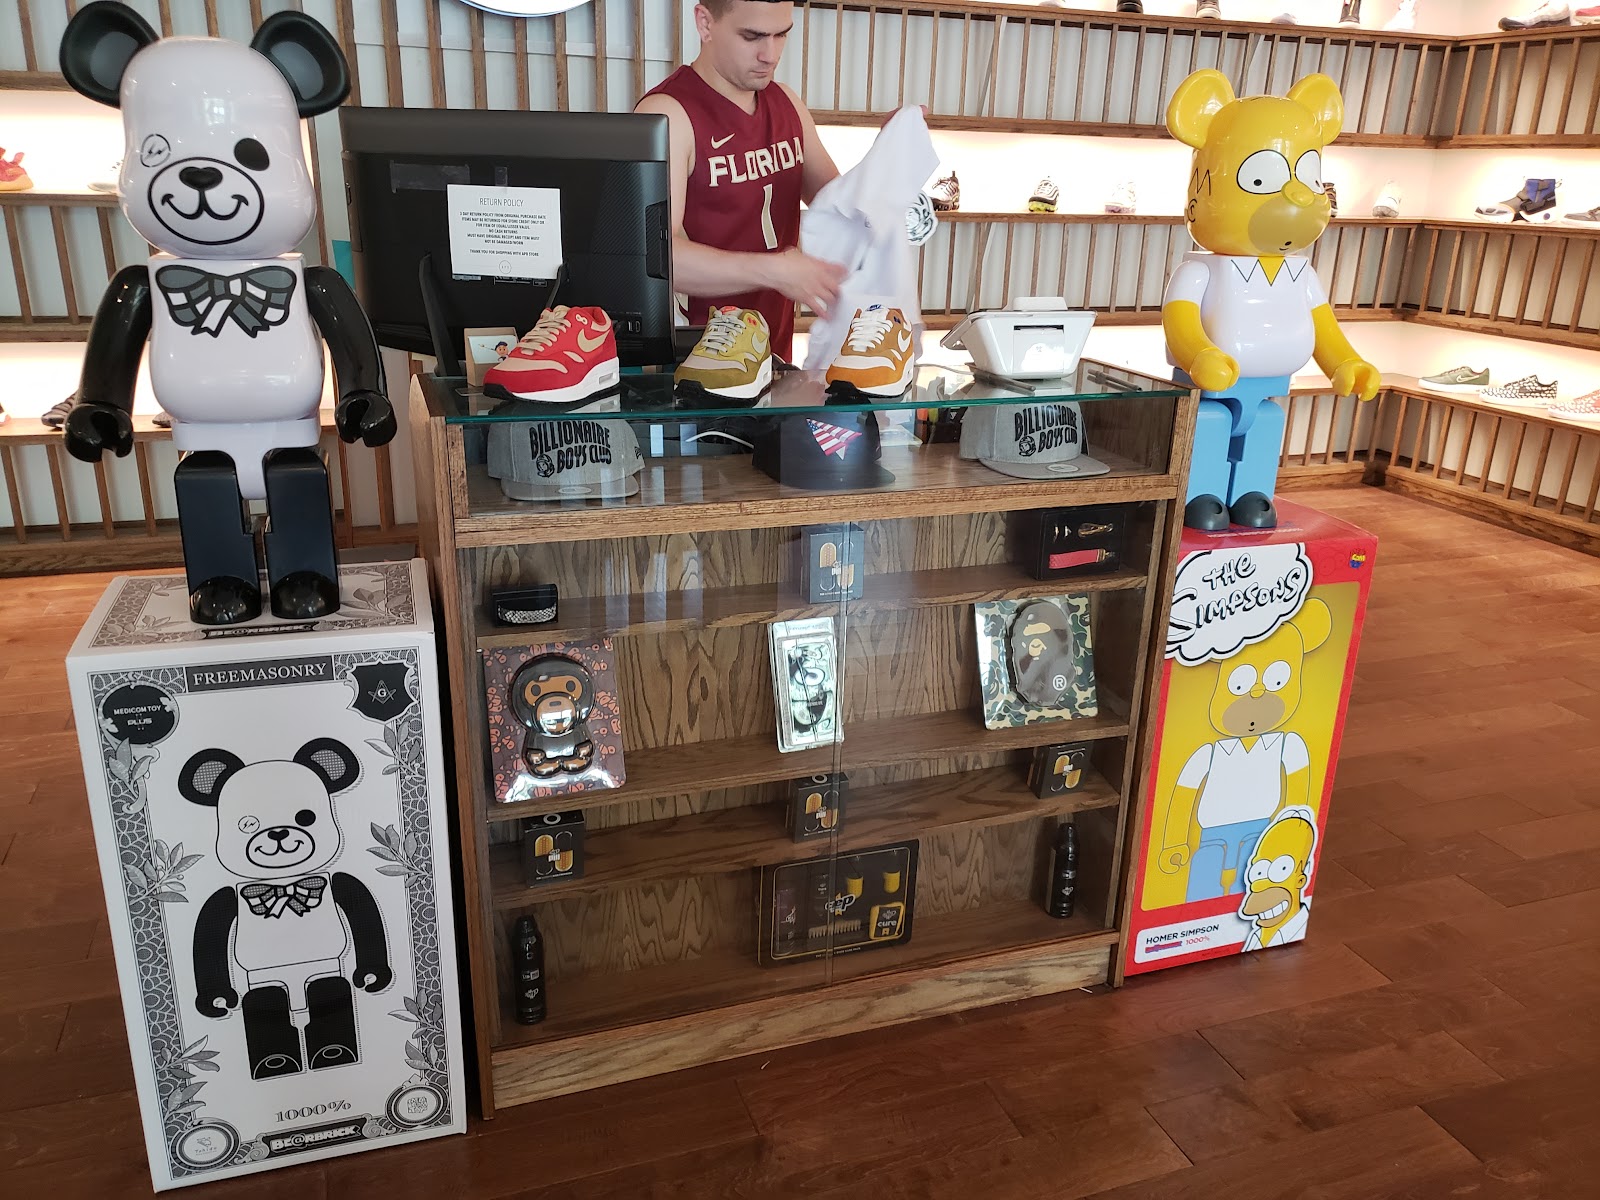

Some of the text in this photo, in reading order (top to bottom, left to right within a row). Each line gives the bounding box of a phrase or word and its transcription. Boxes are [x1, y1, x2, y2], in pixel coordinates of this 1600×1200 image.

[708, 136, 804, 187] FLORIDA
[479, 197, 524, 207] RETURN POLICY
[762, 183, 778, 250] 1
[1014, 404, 1078, 442] BILLIONAIRE
[529, 420, 611, 460] BILLIONAIRE
[1038, 426, 1078, 453] BOYS CLUB
[557, 444, 612, 474] BOYS CLUB
[192, 662, 327, 687] FREEMASONRY
[377, 688, 387, 698] G
[113, 704, 162, 715] MEDICOM TOY
[127, 717, 153, 726] PLUS
[1145, 924, 1220, 945] HOMER SIMPSON
[1185, 935, 1210, 946] 1000%
[275, 1099, 352, 1123] 1000%
